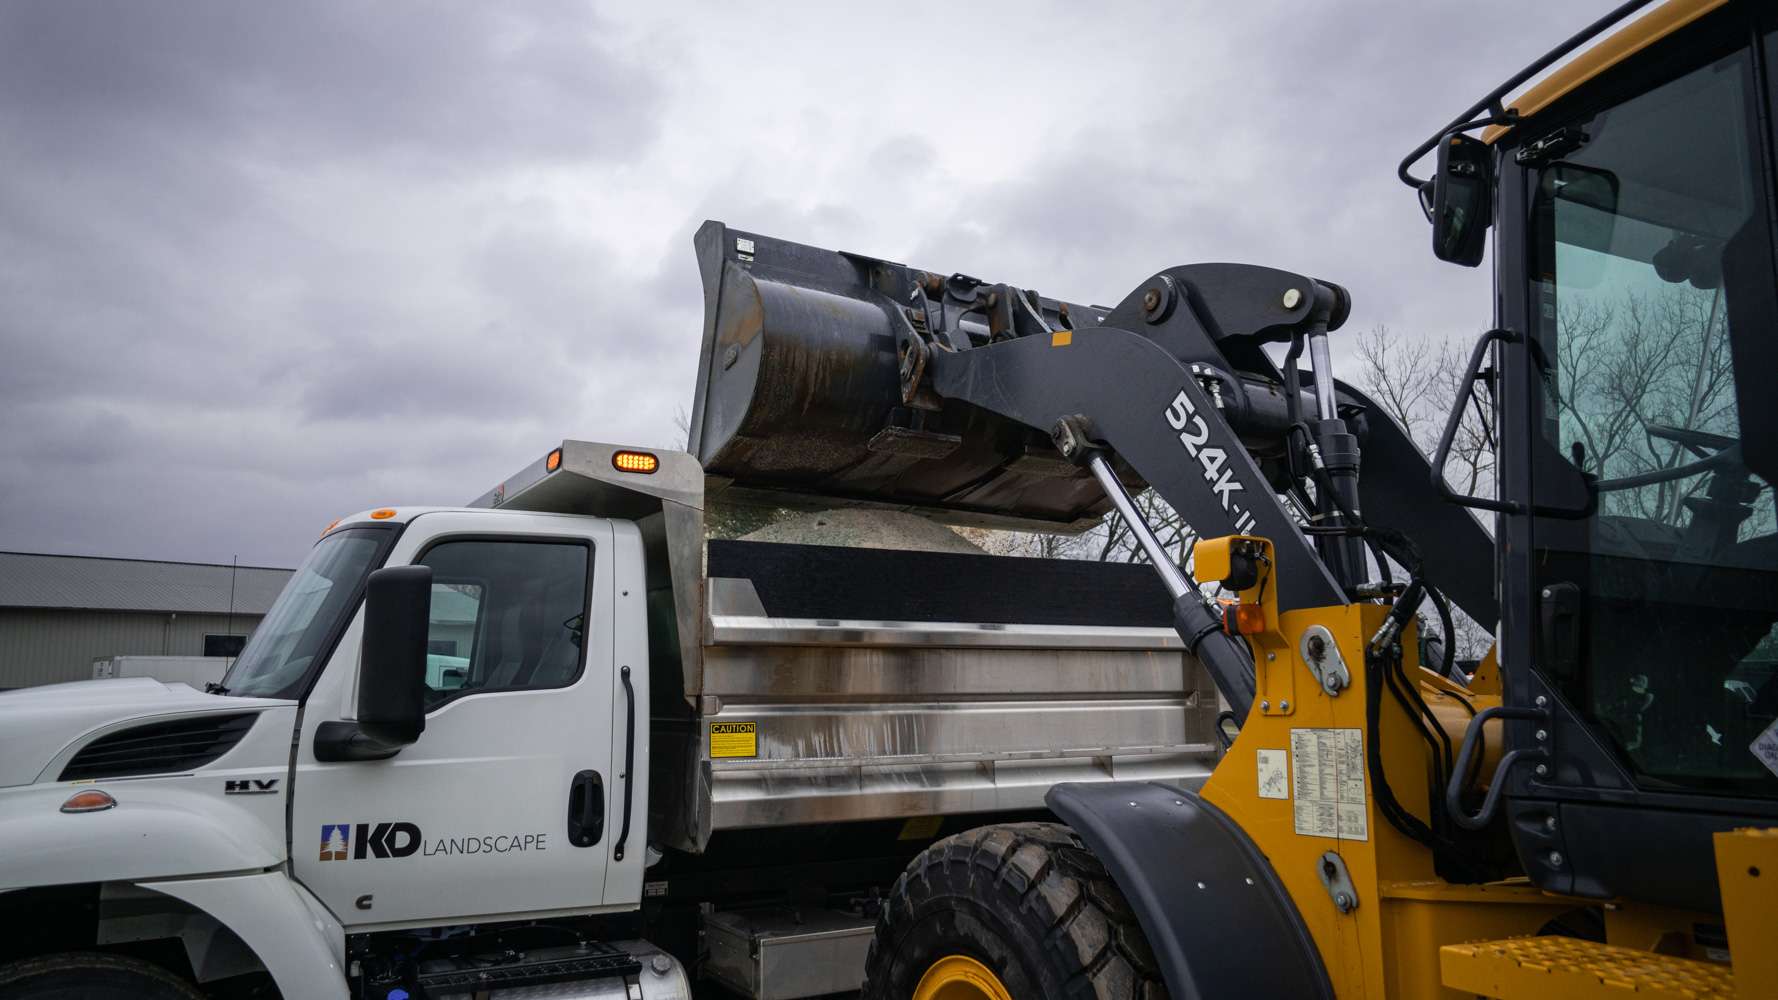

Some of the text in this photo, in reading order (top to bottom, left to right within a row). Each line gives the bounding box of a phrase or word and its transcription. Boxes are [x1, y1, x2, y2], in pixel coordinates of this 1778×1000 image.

[1164, 390, 1256, 536] 524K-II
[712, 725, 754, 733] CAUTION
[224, 779, 280, 791] HV
[353, 822, 547, 860] KD LANDSCAPE
